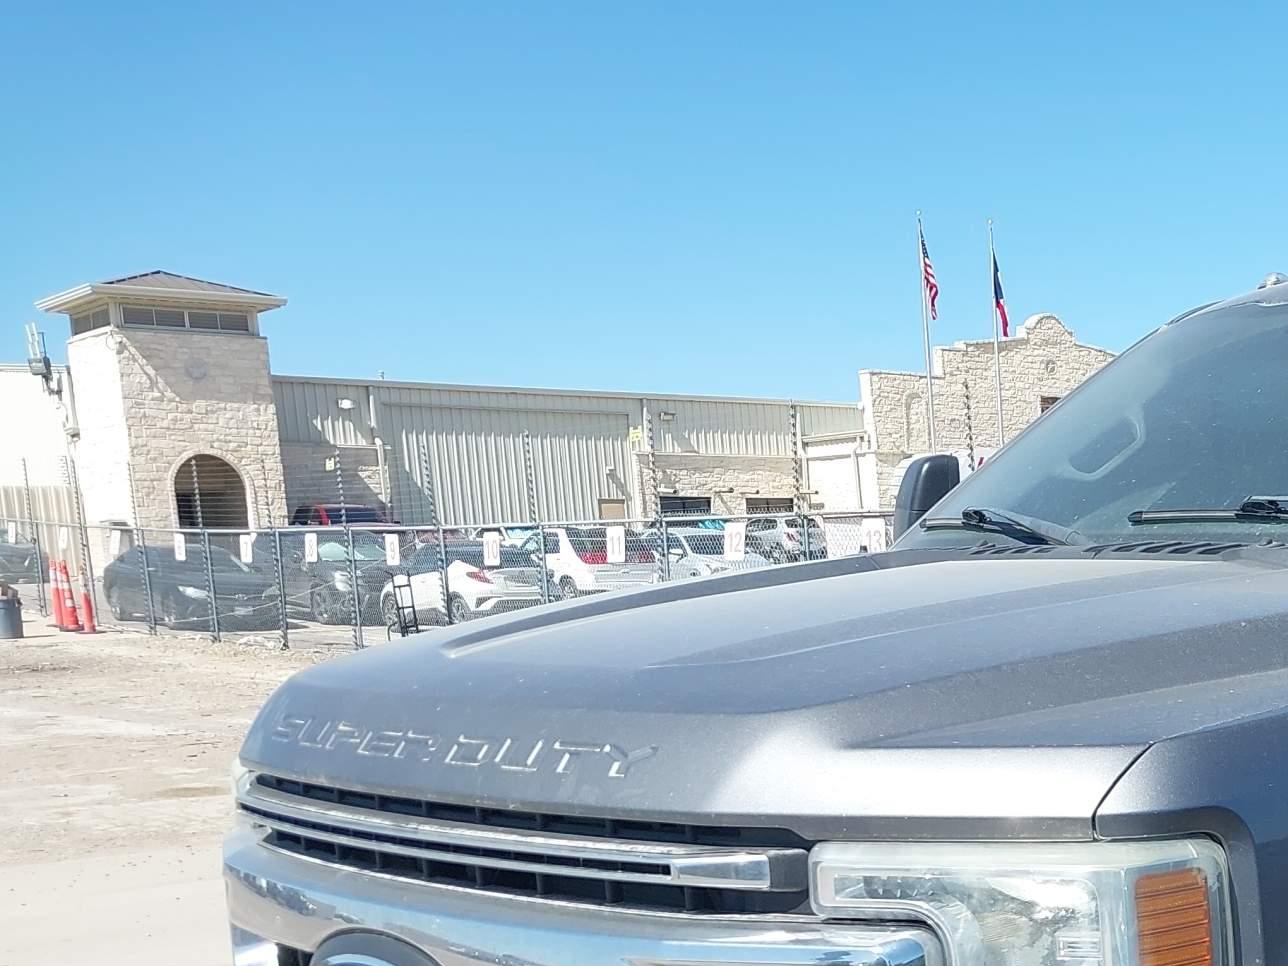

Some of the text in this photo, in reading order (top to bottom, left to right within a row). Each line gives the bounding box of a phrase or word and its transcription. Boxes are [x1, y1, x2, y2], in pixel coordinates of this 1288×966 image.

[486, 539, 499, 559] 10
[609, 536, 622, 556] 11
[727, 531, 743, 553] 12
[866, 529, 883, 551] 13
[271, 715, 659, 778] SUPER DUTY
